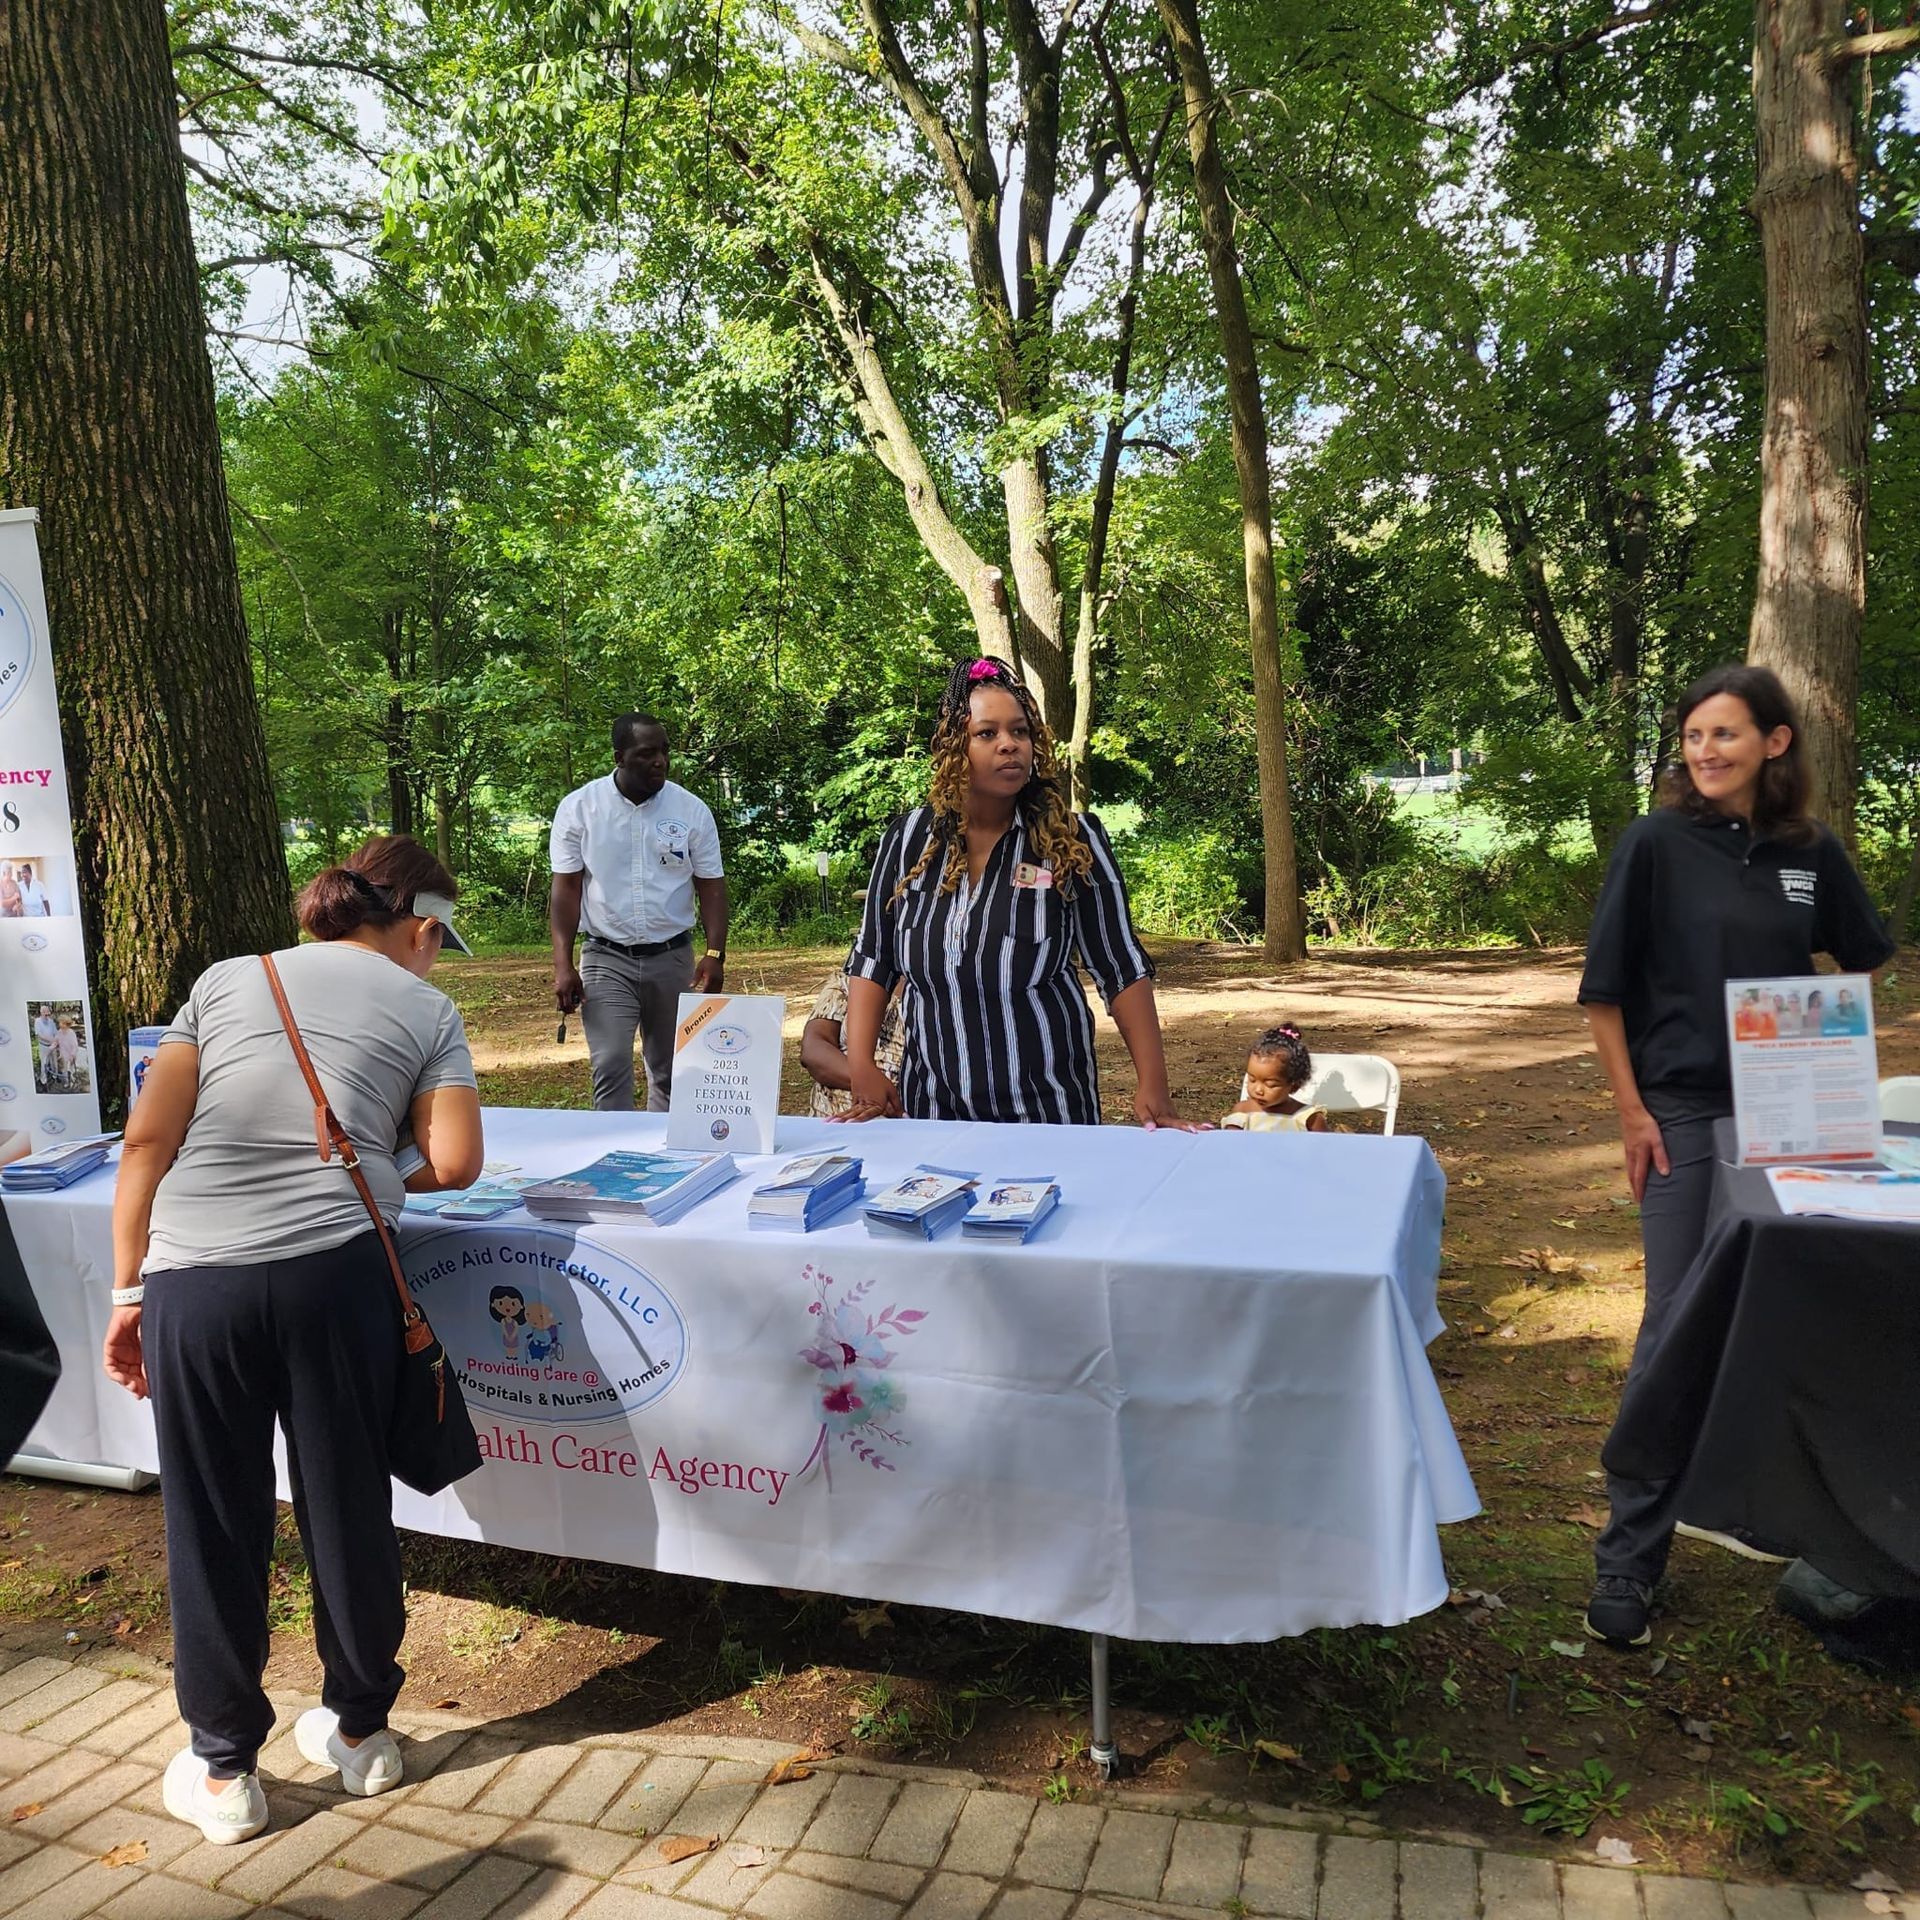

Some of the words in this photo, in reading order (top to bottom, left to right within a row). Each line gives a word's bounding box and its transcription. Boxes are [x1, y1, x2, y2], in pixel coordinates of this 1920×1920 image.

[0, 769, 52, 787] ency
[684, 1006, 713, 1036] Bronze
[713, 1060, 739, 1070] 2023
[704, 1074, 749, 1086] SENIOR
[695, 1088, 752, 1101] FESTIVAL
[696, 1104, 752, 1116] SPONSOR
[408, 1258, 457, 1293] rivate
[462, 1246, 494, 1269] Aid
[499, 1246, 612, 1297] Contractor,
[617, 1286, 660, 1325] LLC
[456, 1368, 534, 1405] Hospitals
[537, 1392, 549, 1406] &
[552, 1384, 619, 1408] Nursing
[618, 1357, 672, 1394] Homes
[467, 1358, 540, 1382] Providing
[544, 1366, 578, 1383] Care
[582, 1370, 600, 1388] @
[477, 1426, 543, 1465] alth
[552, 1433, 638, 1477] Care
[647, 1446, 790, 1505] Agency
